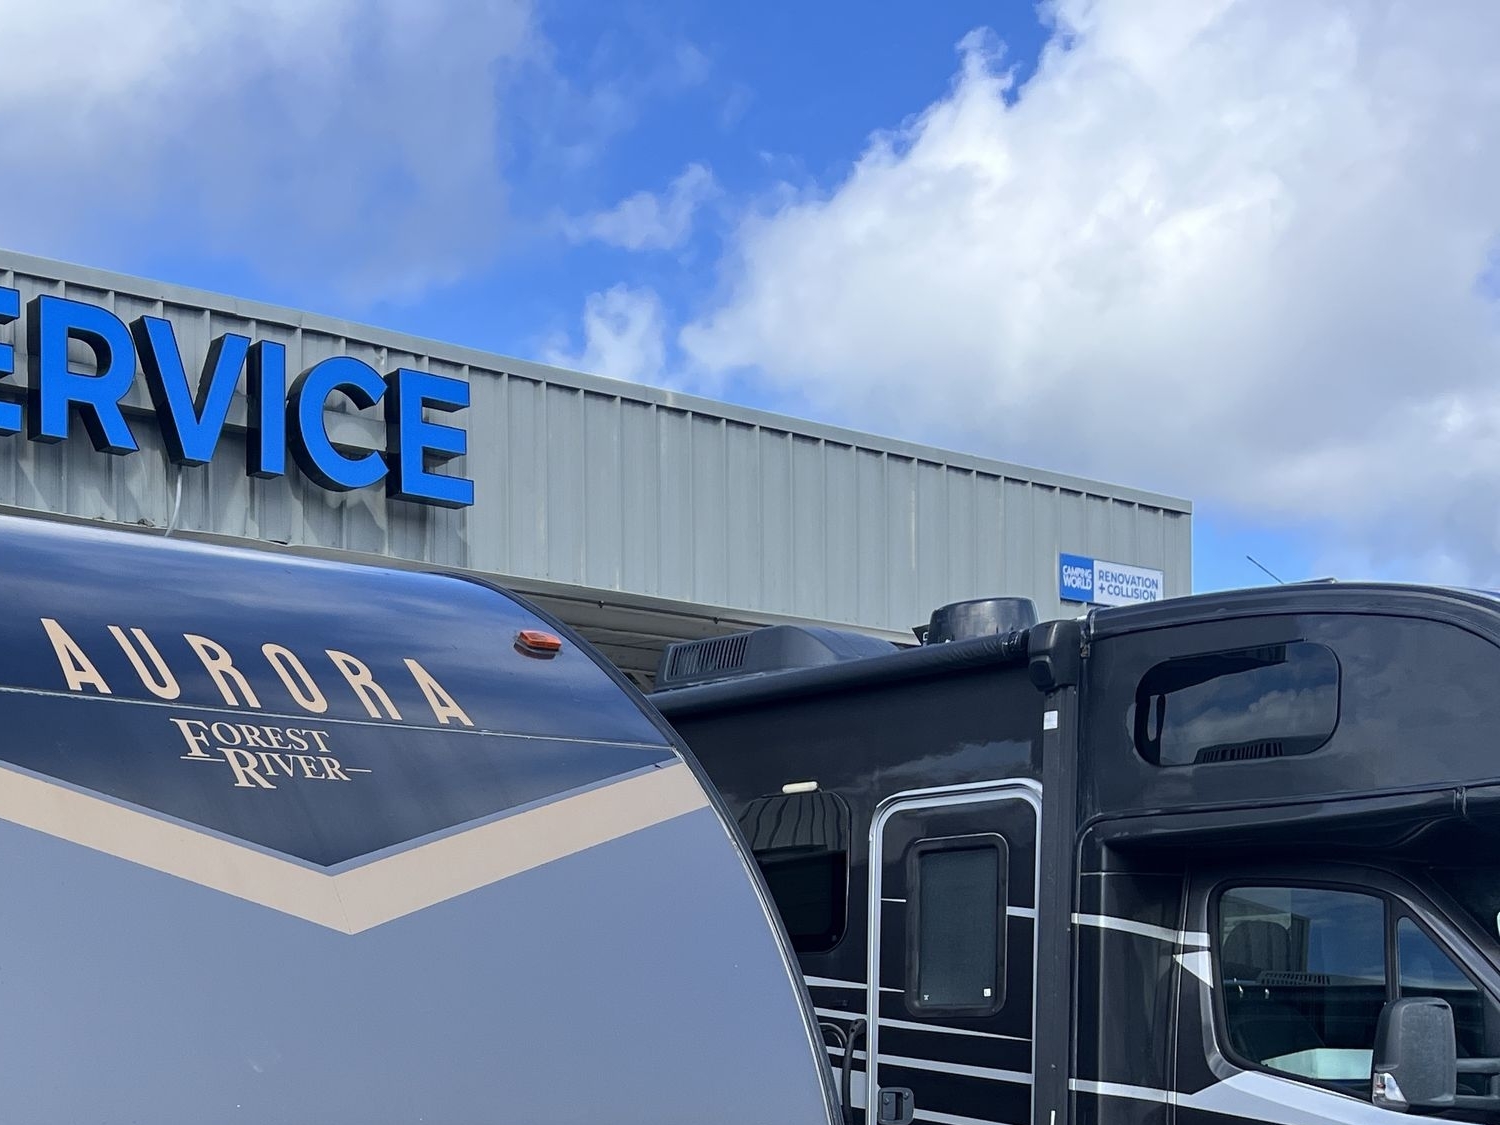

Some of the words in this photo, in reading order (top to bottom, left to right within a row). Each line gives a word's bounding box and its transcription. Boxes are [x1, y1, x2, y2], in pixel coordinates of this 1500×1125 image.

[1063, 565, 1092, 579] CAMPING
[1099, 570, 1158, 589] RENOVATION
[1063, 575, 1092, 590] WORLD
[1107, 585, 1157, 602] COLLISION
[40, 617, 475, 727] AURORA
[169, 717, 332, 758] FOREST
[216, 747, 352, 789] RIVER
